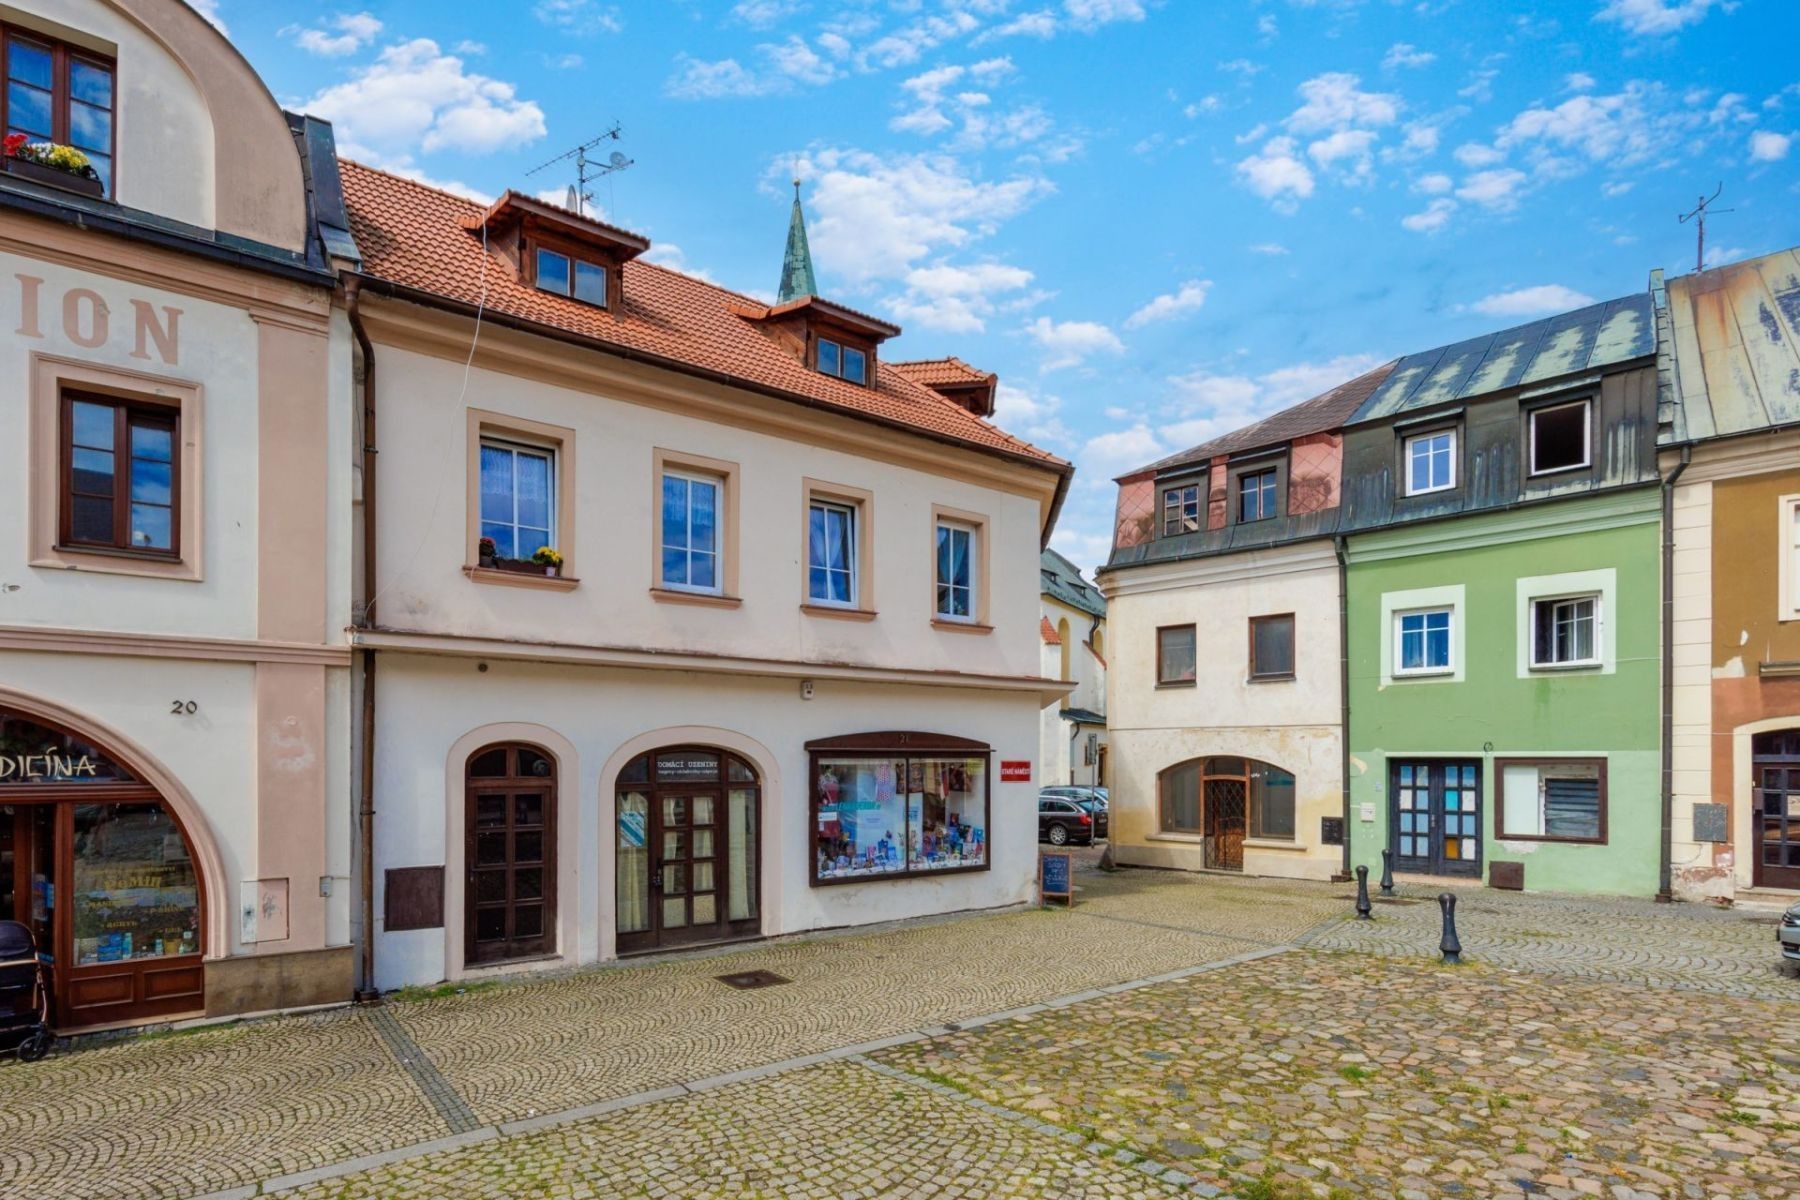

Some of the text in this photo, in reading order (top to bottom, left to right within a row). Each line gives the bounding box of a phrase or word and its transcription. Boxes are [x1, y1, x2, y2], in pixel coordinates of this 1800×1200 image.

[15, 273, 184, 365] ION
[171, 700, 198, 715] 20
[657, 760, 684, 768] DOMÁCÍ
